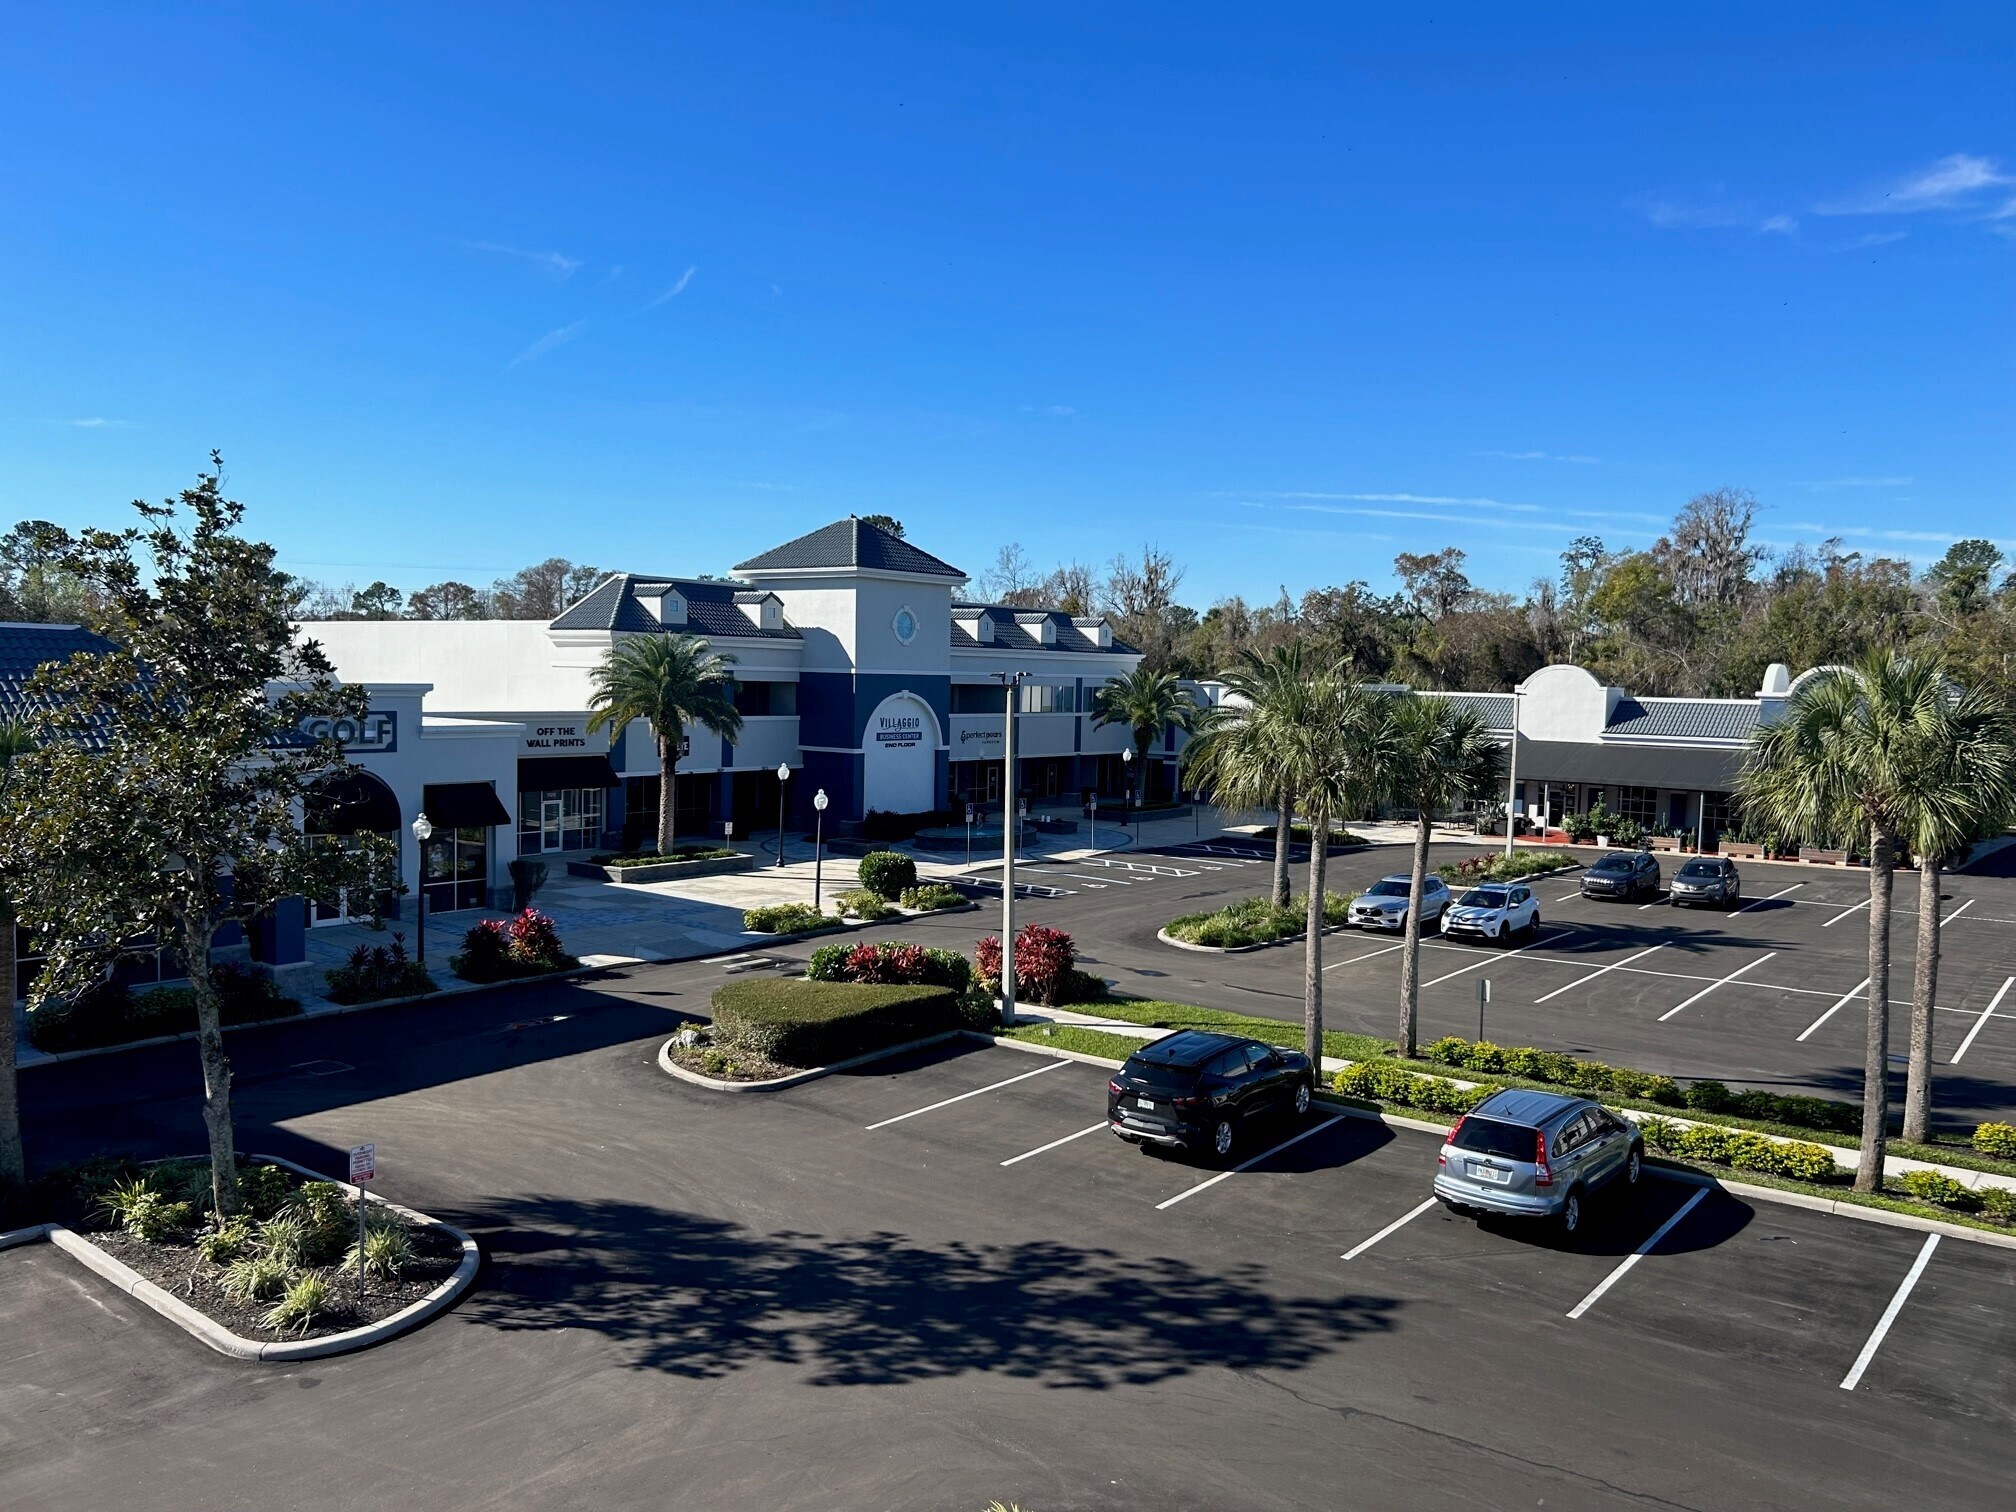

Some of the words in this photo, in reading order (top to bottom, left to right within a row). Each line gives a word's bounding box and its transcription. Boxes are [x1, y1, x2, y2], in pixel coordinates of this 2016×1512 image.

[880, 717, 920, 731] VILLAGGIO
[308, 720, 392, 744] GOLF
[557, 727, 576, 735] THE
[526, 740, 551, 748] WALL
[553, 739, 586, 747] PRINTS
